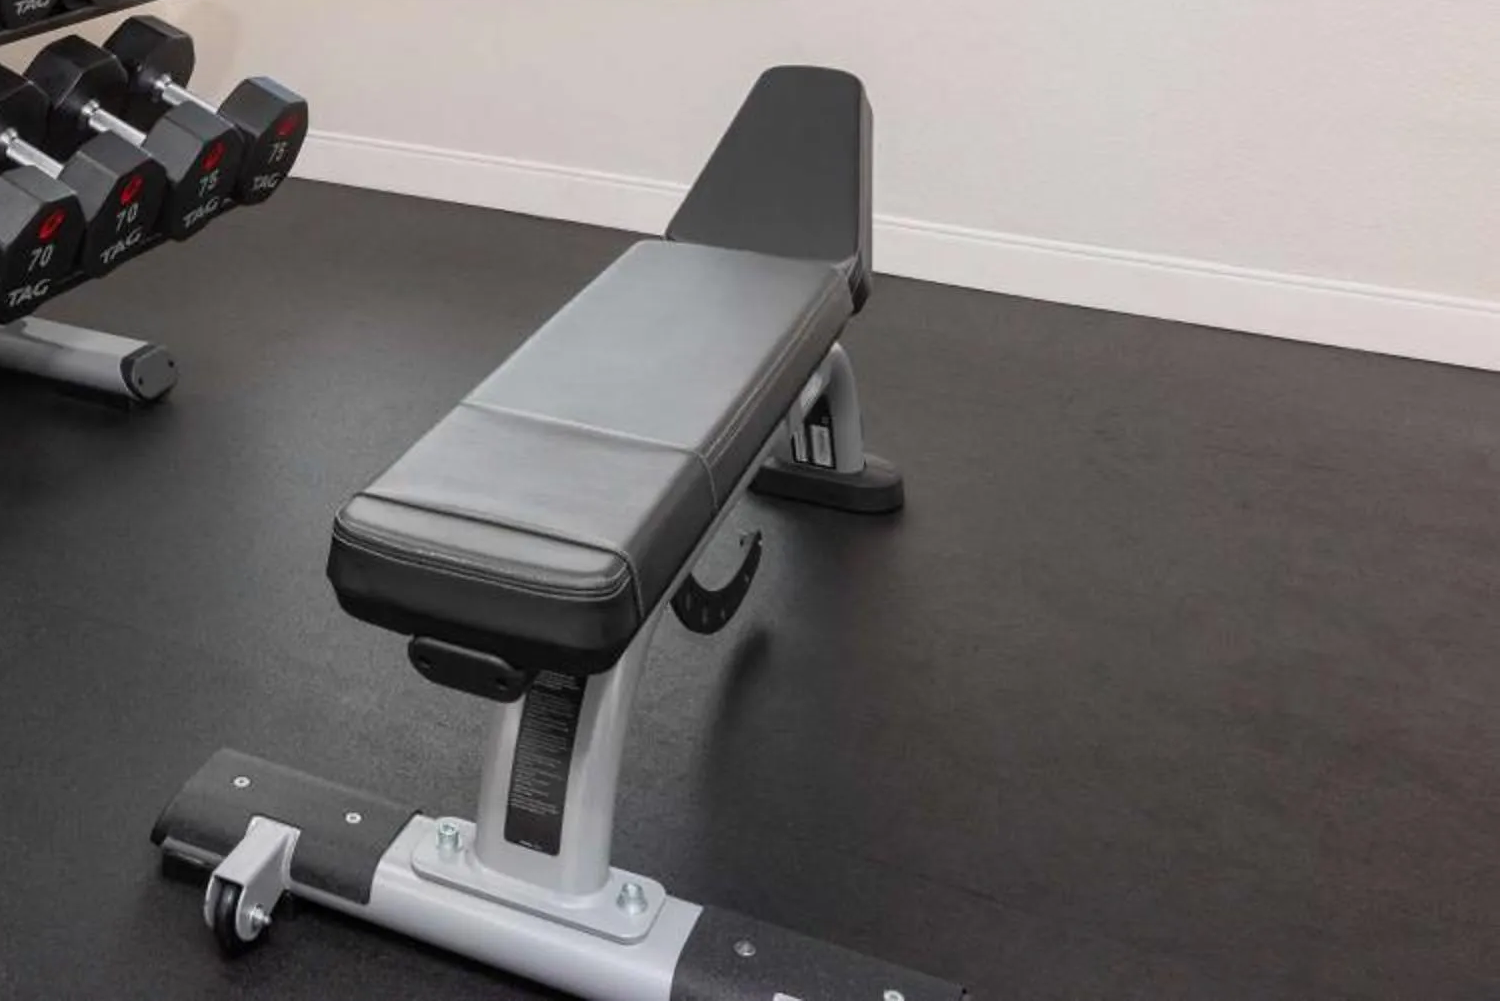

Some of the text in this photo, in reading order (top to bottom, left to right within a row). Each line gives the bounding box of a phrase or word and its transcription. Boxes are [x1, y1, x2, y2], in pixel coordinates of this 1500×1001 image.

[268, 141, 288, 163] 75
[198, 170, 220, 197] 75
[252, 172, 280, 193] TAG
[116, 202, 139, 230] 70
[182, 197, 220, 231] TAG
[28, 244, 54, 270] 70
[99, 228, 145, 265] TAG
[8, 278, 53, 309] TAG
